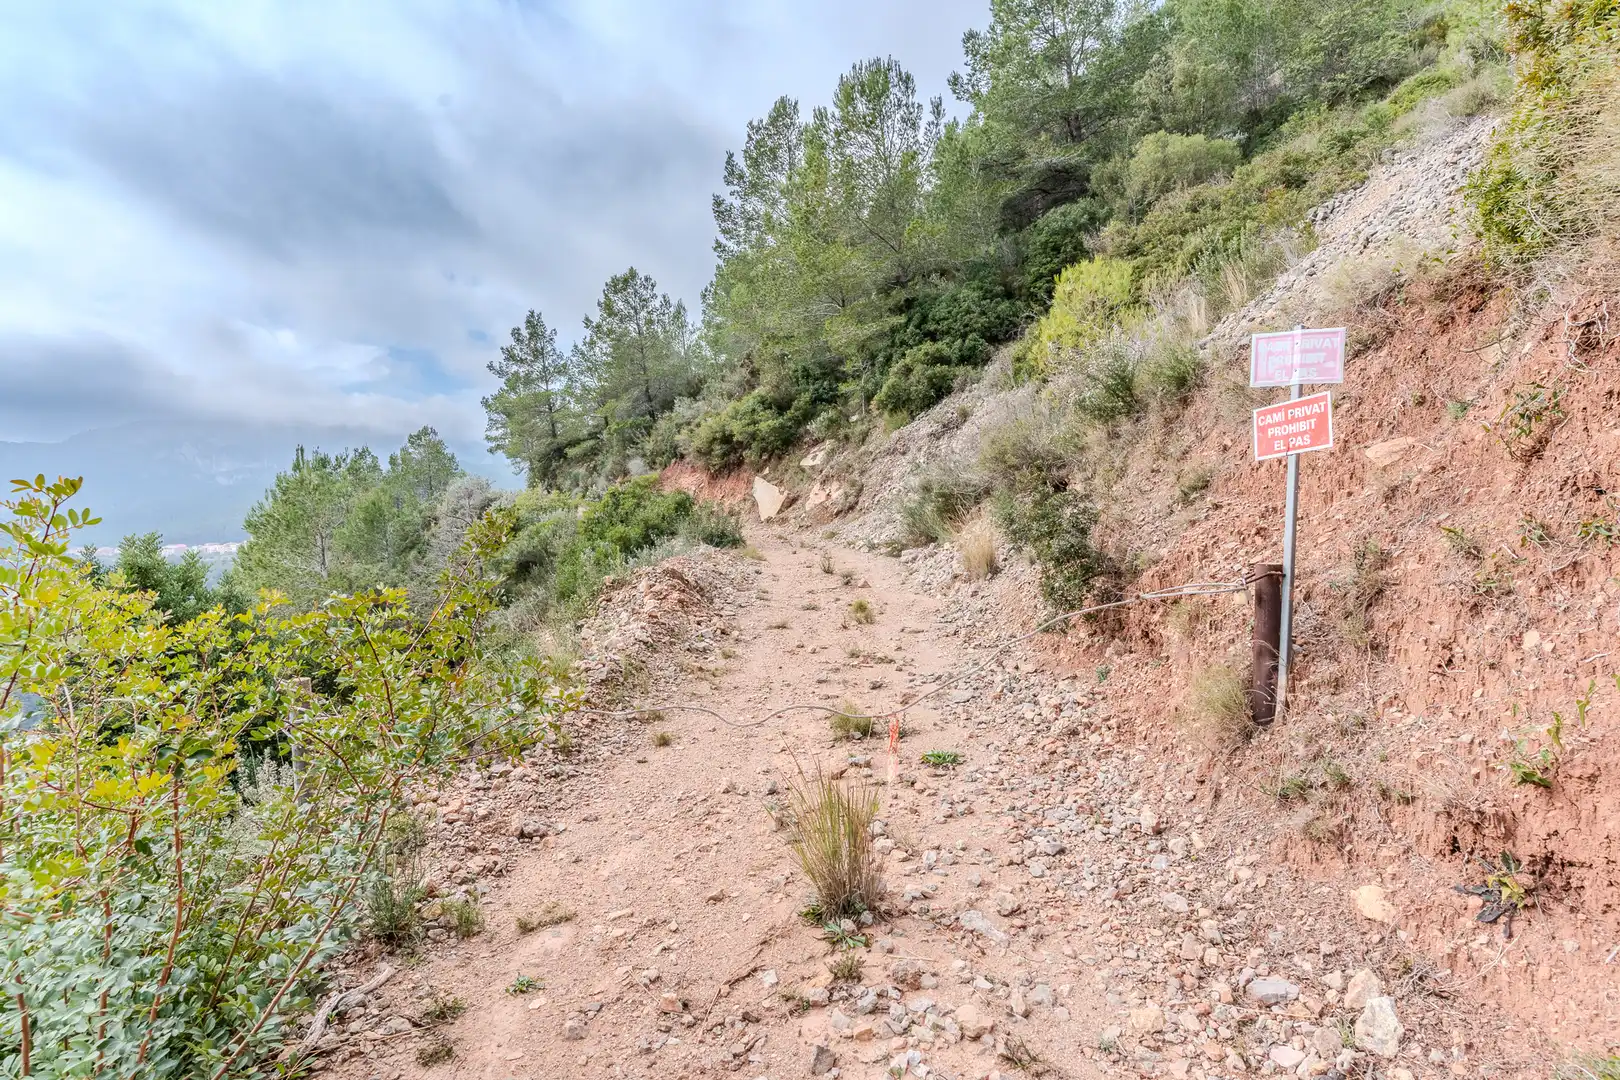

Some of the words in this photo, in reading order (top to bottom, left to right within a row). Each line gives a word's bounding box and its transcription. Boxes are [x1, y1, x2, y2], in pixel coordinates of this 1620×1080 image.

[1258, 408, 1285, 426] CAMÍ
[1287, 401, 1326, 420] PRIVAT
[1268, 418, 1317, 438] PROHIBIT
[1274, 439, 1286, 451] EL
[1288, 434, 1311, 448] PAS
